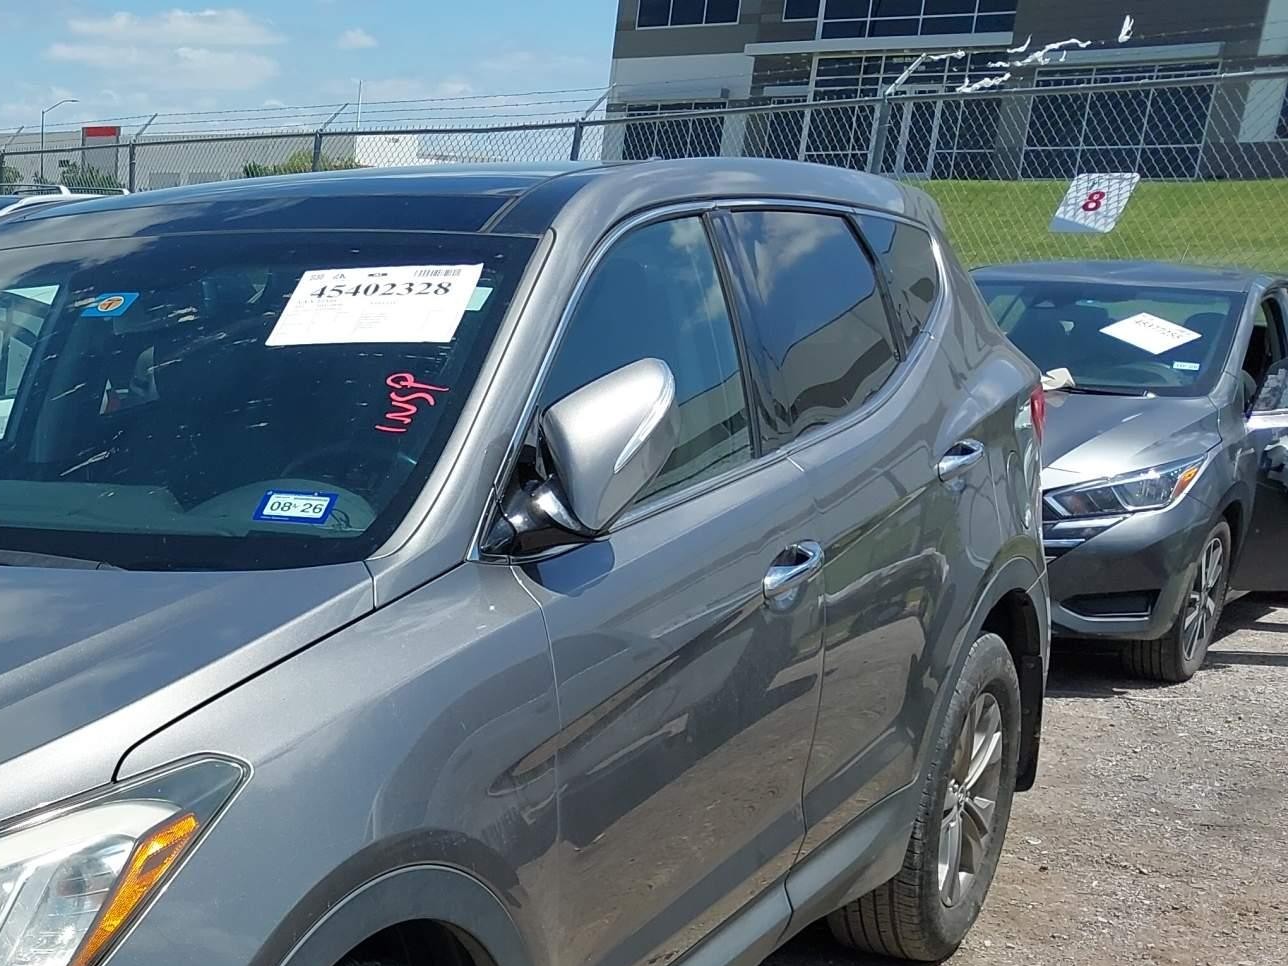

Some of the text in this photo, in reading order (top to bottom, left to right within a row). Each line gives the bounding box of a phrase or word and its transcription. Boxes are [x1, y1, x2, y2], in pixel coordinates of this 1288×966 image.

[1082, 191, 1106, 212] 8
[311, 281, 452, 299] 45402328
[375, 373, 449, 432] INSP
[270, 501, 324, 514] 08 26
